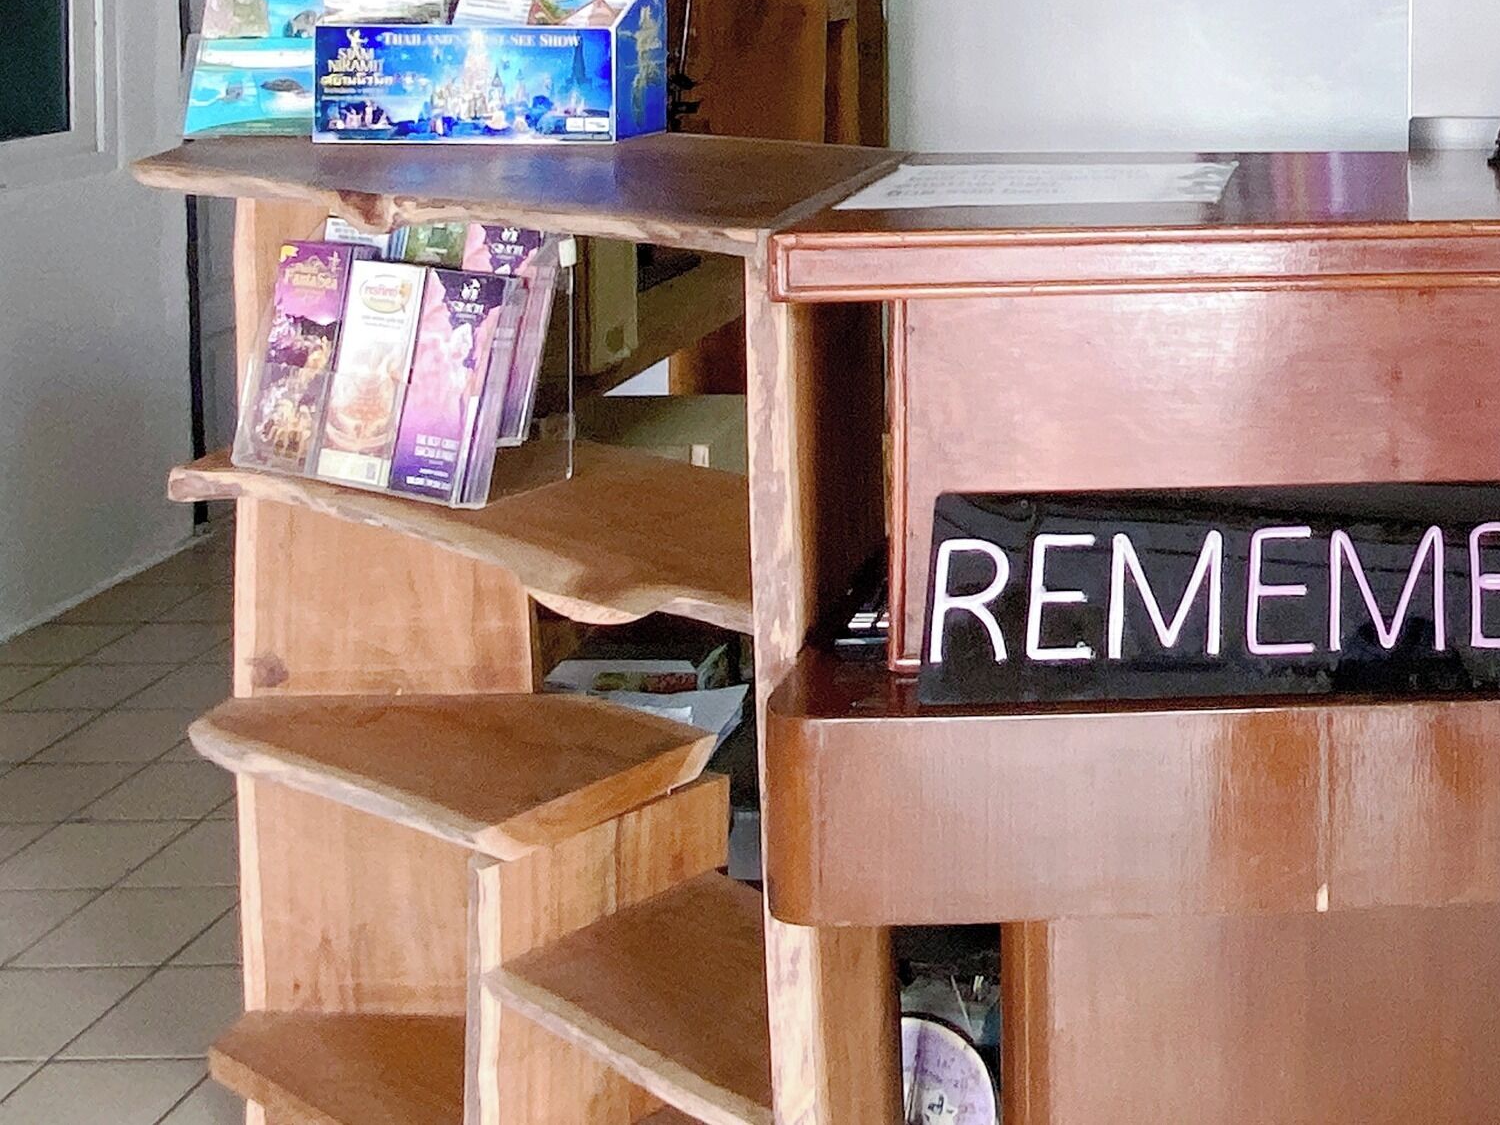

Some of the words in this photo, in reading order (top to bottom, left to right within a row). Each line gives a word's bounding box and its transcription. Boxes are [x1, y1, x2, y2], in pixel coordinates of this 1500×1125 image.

[538, 32, 581, 48] SHOW
[337, 46, 375, 60] SIAM
[327, 58, 384, 73] NIRAMIT
